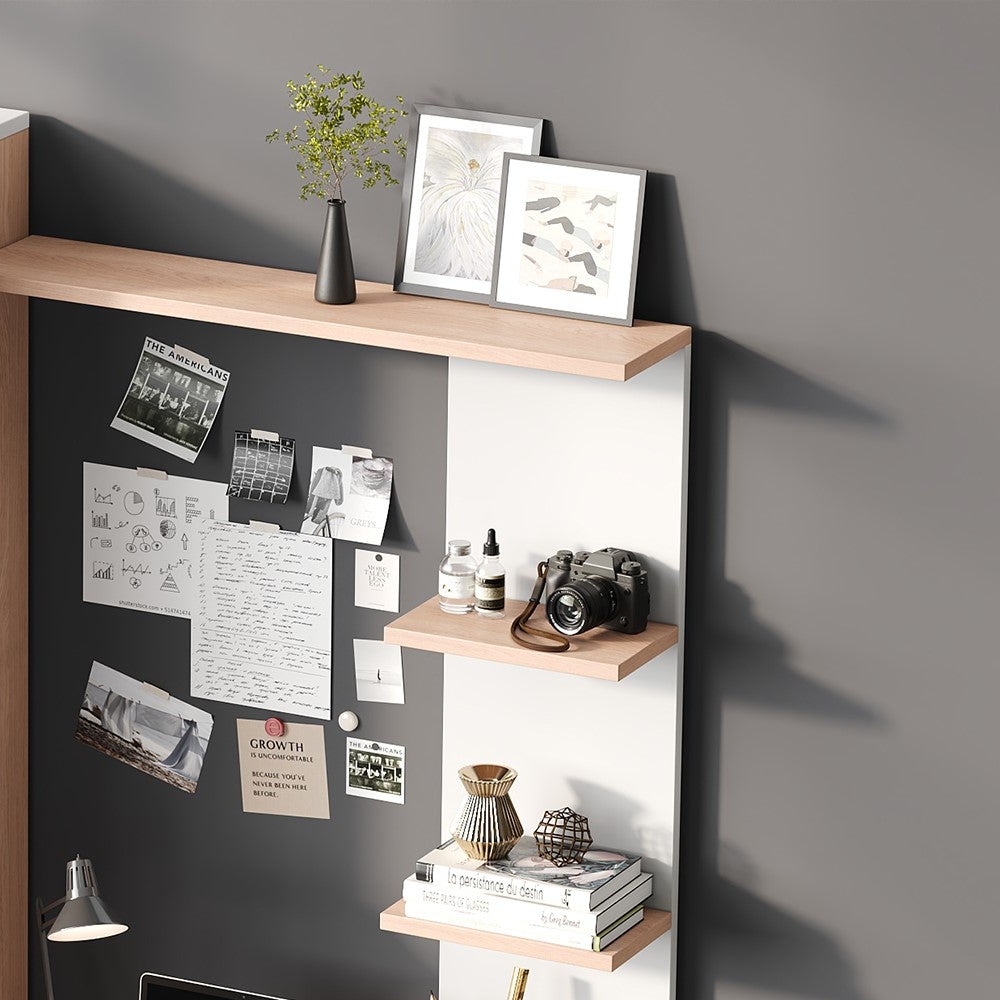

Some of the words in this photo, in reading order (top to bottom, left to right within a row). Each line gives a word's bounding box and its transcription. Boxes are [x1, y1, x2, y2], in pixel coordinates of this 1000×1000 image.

[146, 339, 166, 354] THE
[364, 569, 390, 579] TALENT
[368, 575, 386, 583] LESS
[368, 580, 384, 588] EGO
[250, 738, 304, 752] GROWTH
[258, 752, 314, 763] UNCOMFORTABLE
[252, 771, 280, 779] BECAUSE
[281, 773, 306, 781] YOU'VE
[274, 782, 291, 790] BEEN
[253, 790, 279, 798] BEFORE.
[447, 869, 457, 885] La
[459, 874, 504, 894] persistance
[506, 878, 518, 895] du
[519, 881, 544, 901] destin
